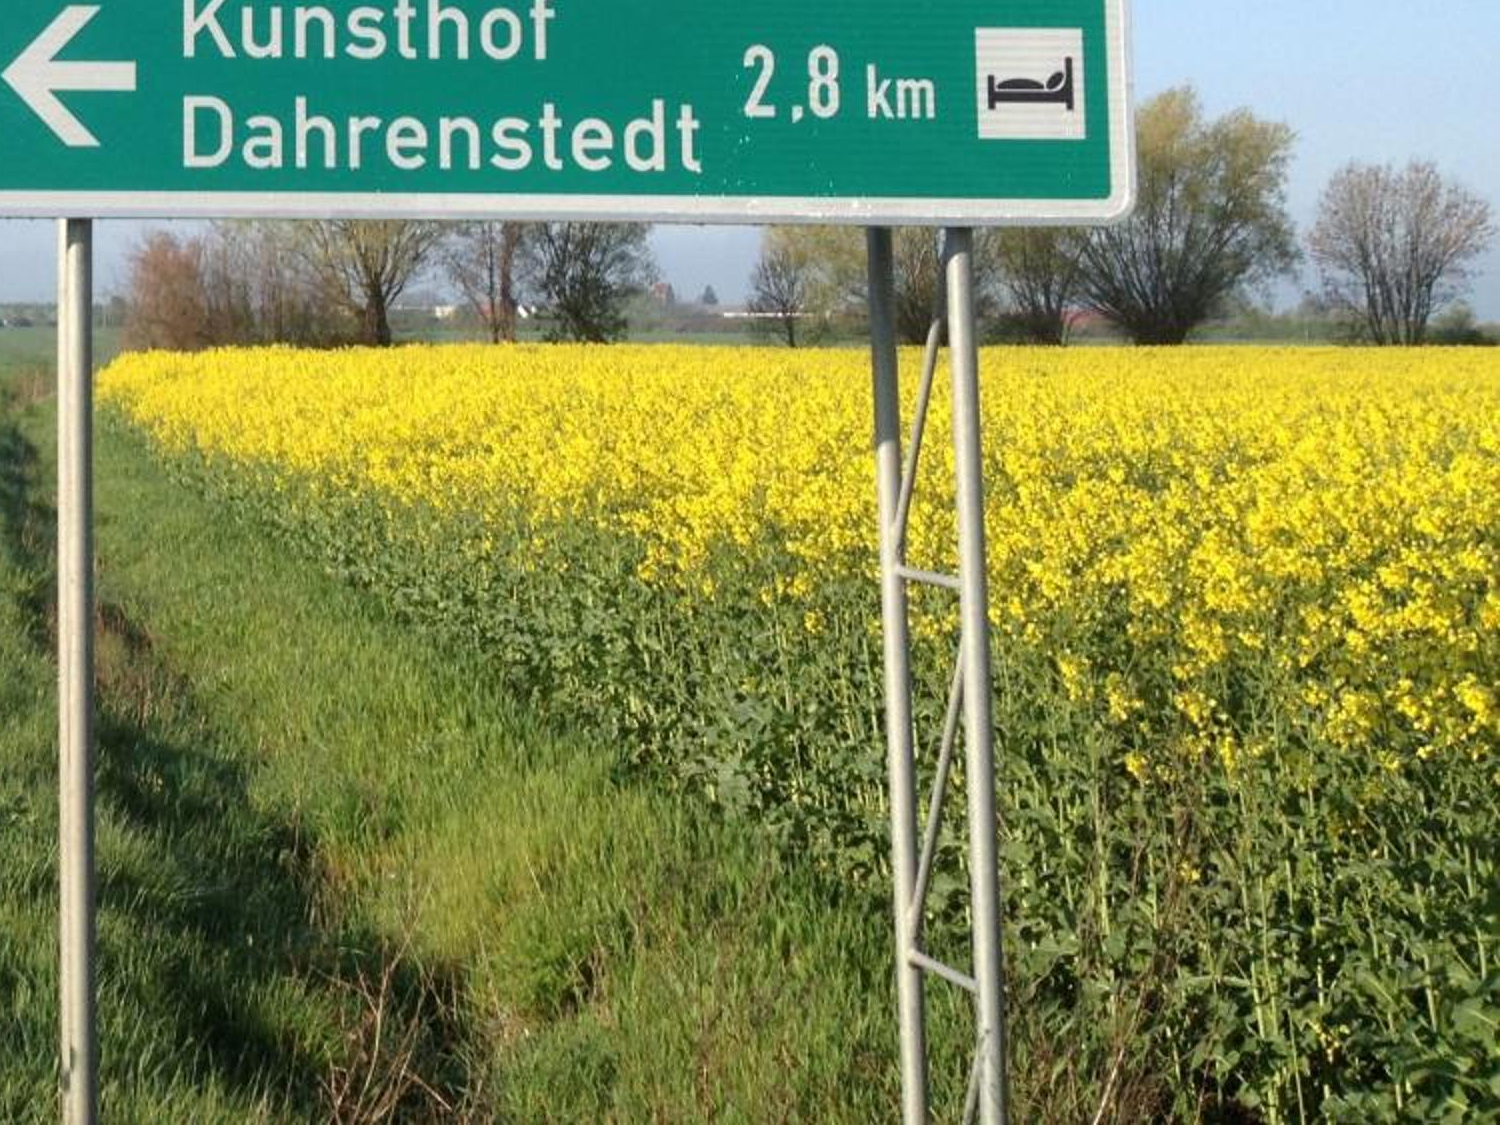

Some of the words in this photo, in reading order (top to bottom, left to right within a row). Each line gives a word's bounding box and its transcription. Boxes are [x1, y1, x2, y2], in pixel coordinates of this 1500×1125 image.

[742, 43, 841, 124] 2,8
[866, 63, 936, 120] km
[182, 94, 703, 175] Dahrenstedt
